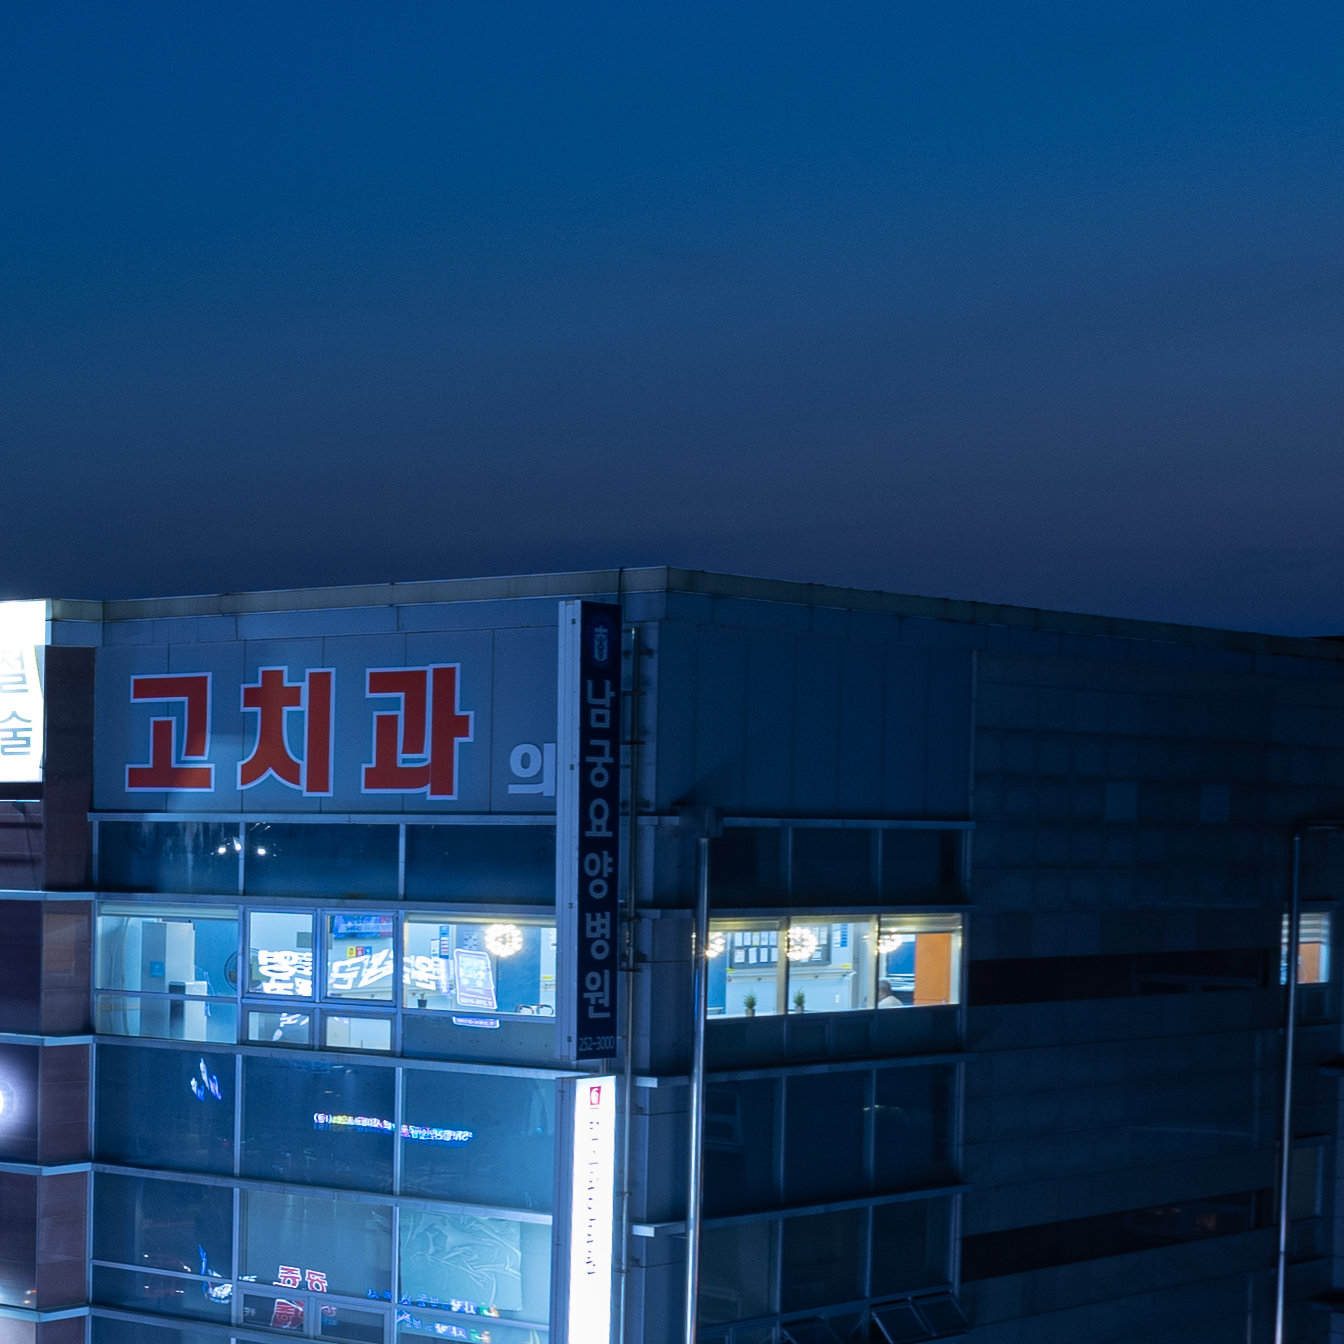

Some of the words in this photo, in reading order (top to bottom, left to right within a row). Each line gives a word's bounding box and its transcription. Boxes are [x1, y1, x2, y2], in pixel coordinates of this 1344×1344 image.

[125, 662, 475, 800] 고치과
[583, 679, 615, 1018] 남궁요양병원
[578, 1035, 614, 1052] 252-3000
